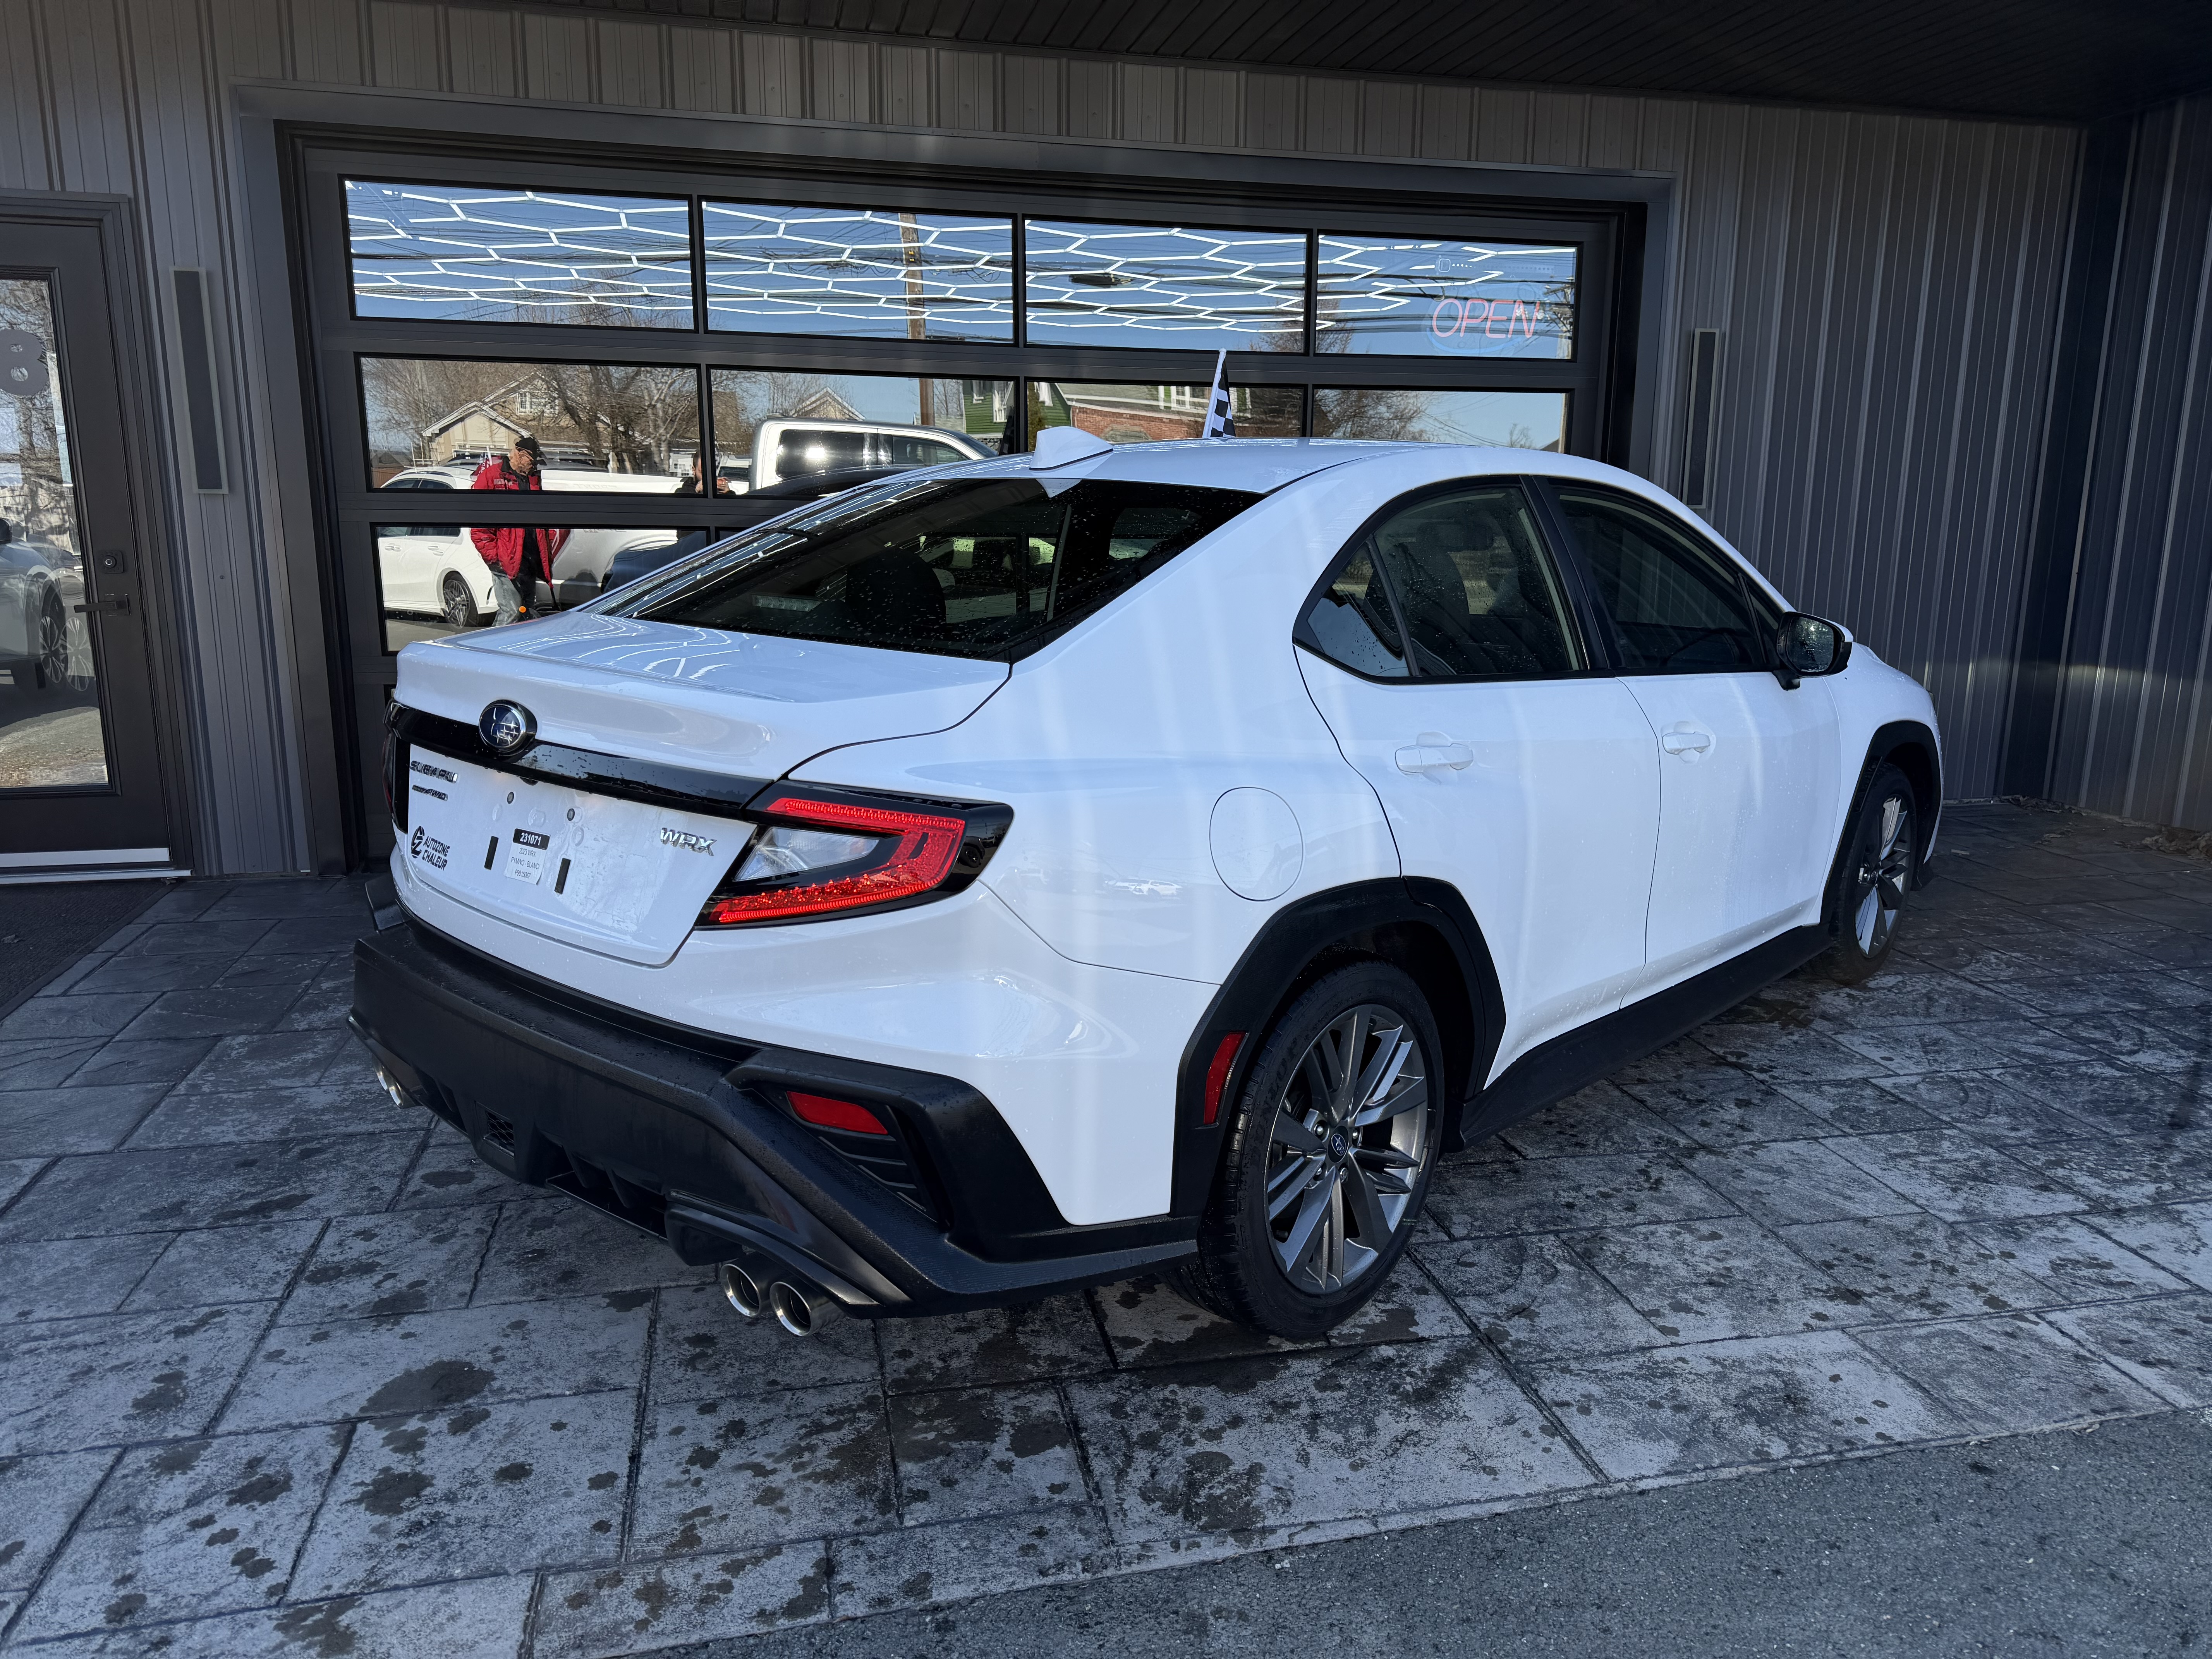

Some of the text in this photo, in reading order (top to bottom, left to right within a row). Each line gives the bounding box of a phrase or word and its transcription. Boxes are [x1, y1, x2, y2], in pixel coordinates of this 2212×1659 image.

[1432, 298, 1540, 338] OPEN
[410, 761, 458, 783] SUBARU
[423, 836, 450, 857] AUTOZONE
[520, 832, 541, 846] 231071
[660, 828, 717, 856] WRX
[422, 849, 448, 871] CHALEUR
[528, 849, 537, 857] WRX
